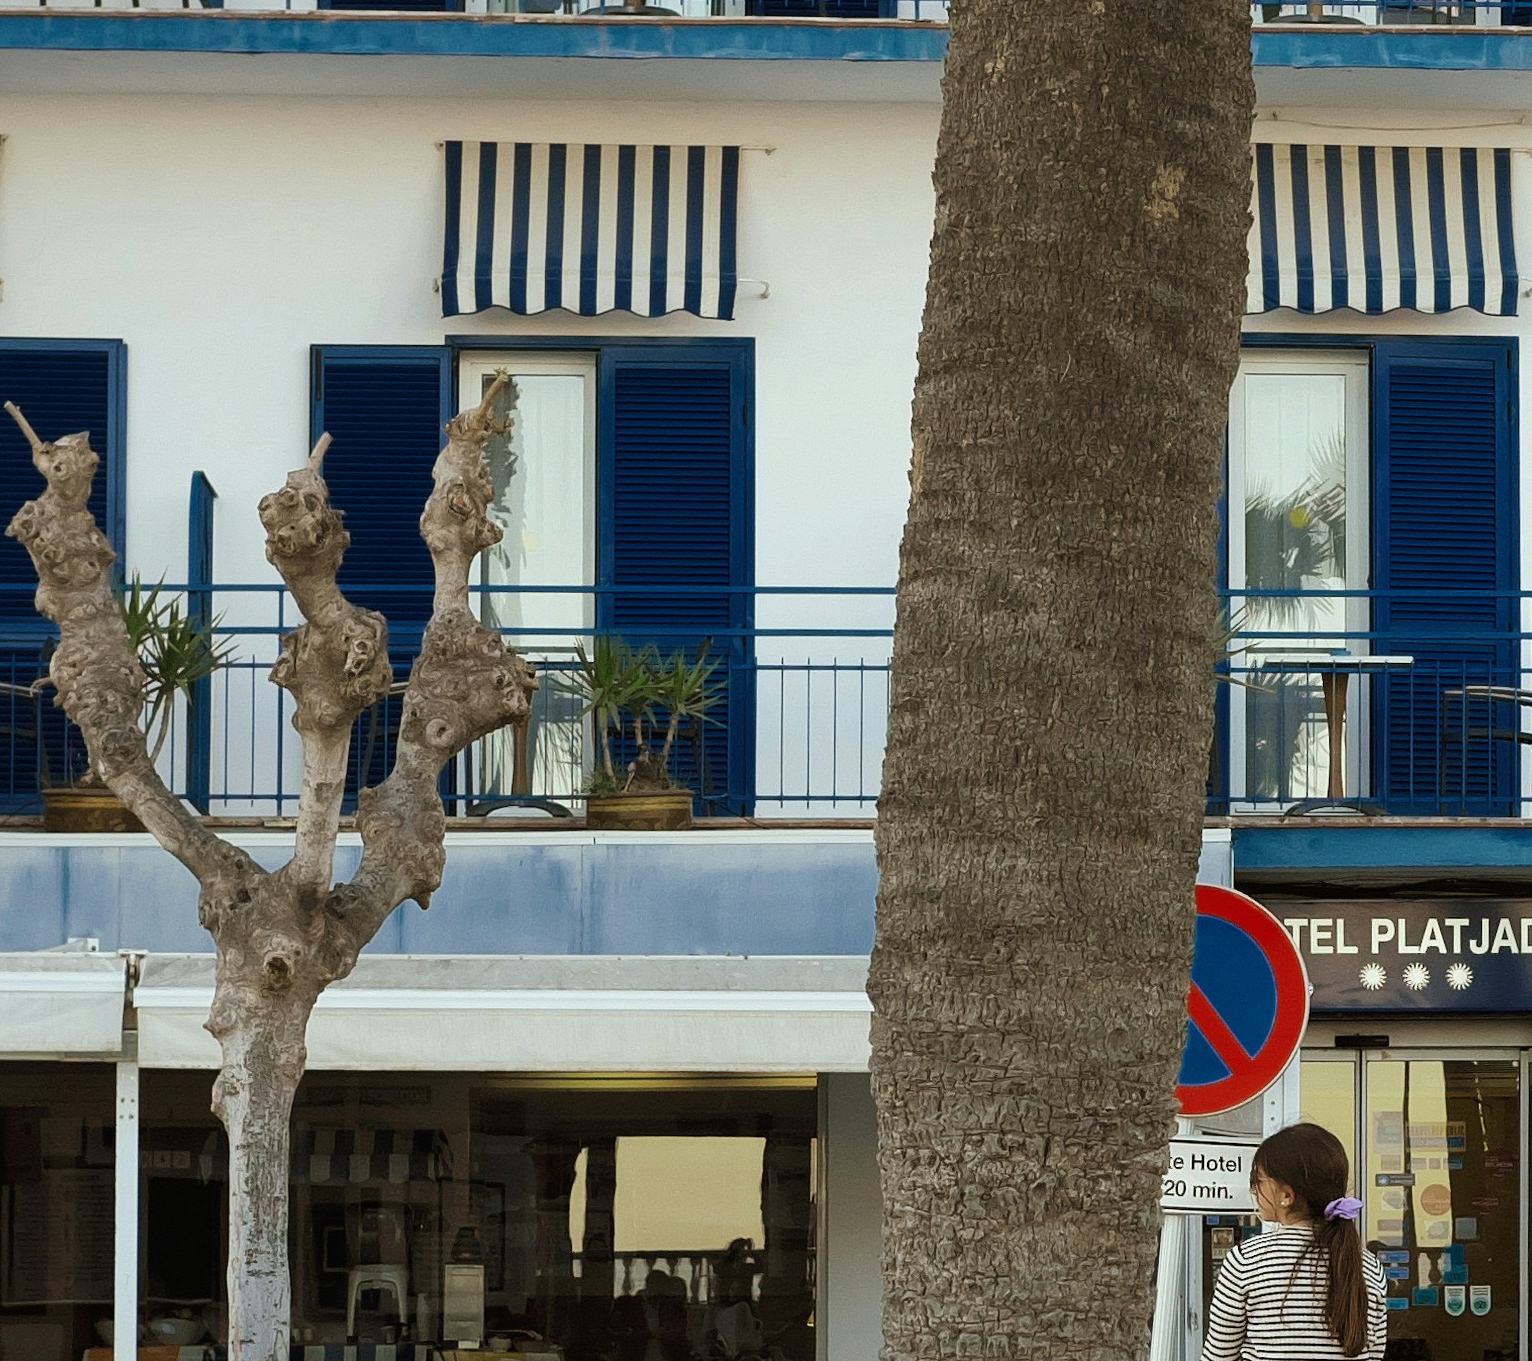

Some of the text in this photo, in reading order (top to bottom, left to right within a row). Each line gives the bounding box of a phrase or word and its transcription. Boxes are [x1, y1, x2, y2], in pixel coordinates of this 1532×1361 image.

[1283, 918, 1359, 954] TEL
[1191, 1153, 1242, 1173] Hotel
[1164, 1179, 1234, 1199] 20 min.
